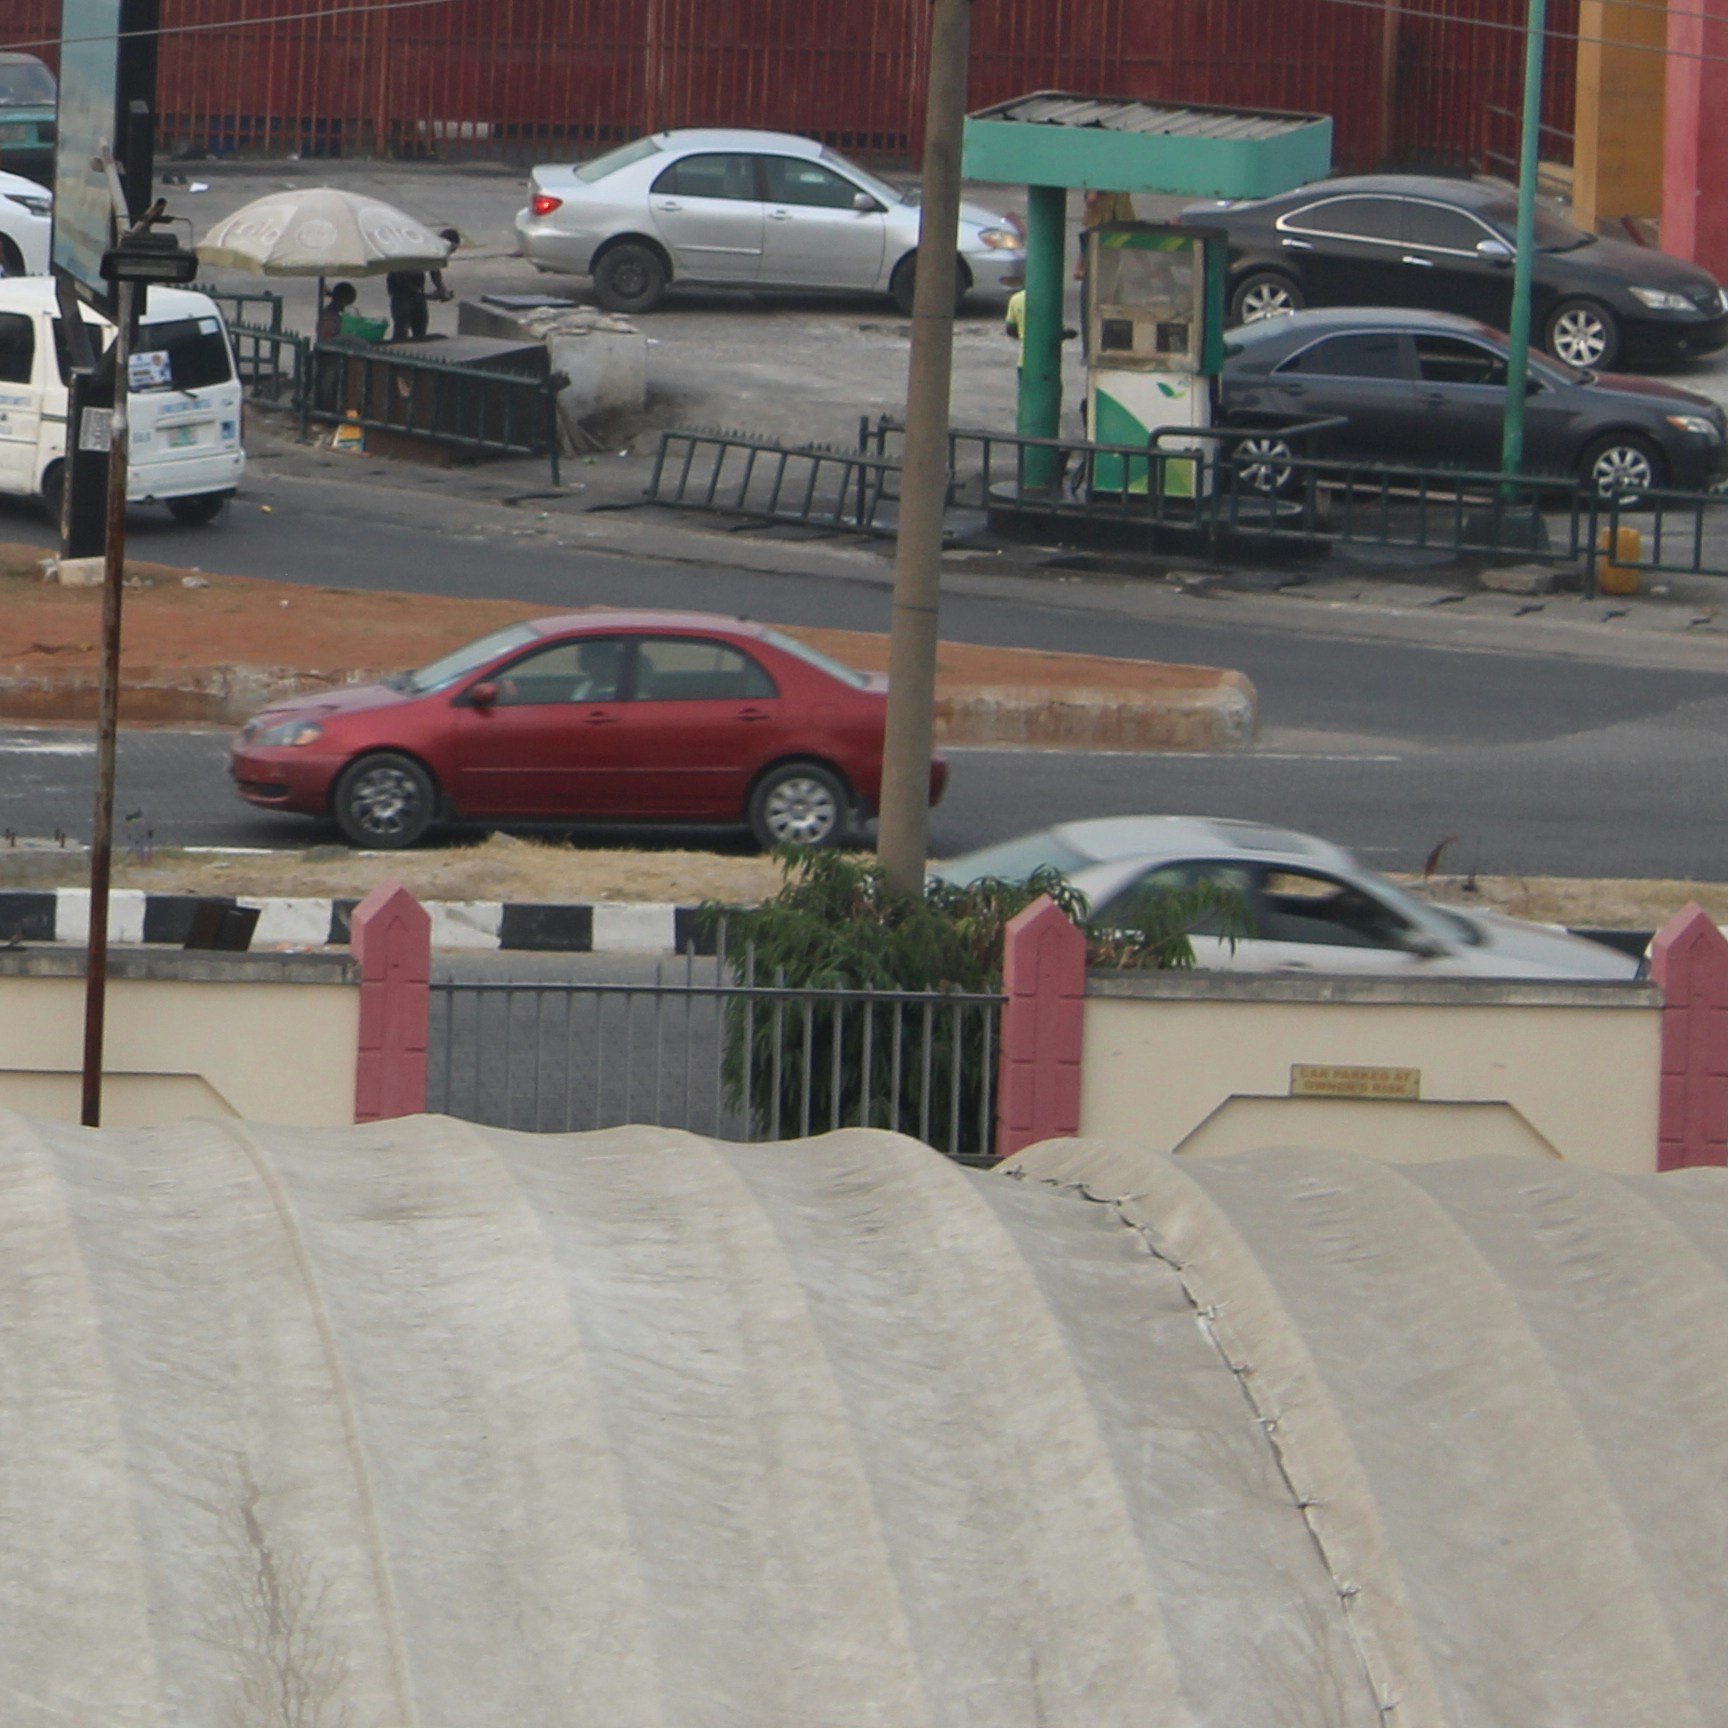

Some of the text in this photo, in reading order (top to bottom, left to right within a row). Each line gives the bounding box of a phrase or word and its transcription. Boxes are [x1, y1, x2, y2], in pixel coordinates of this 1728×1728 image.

[1299, 1068, 1411, 1082] CAR PARKED AT
[1372, 1083, 1408, 1094] RISK
